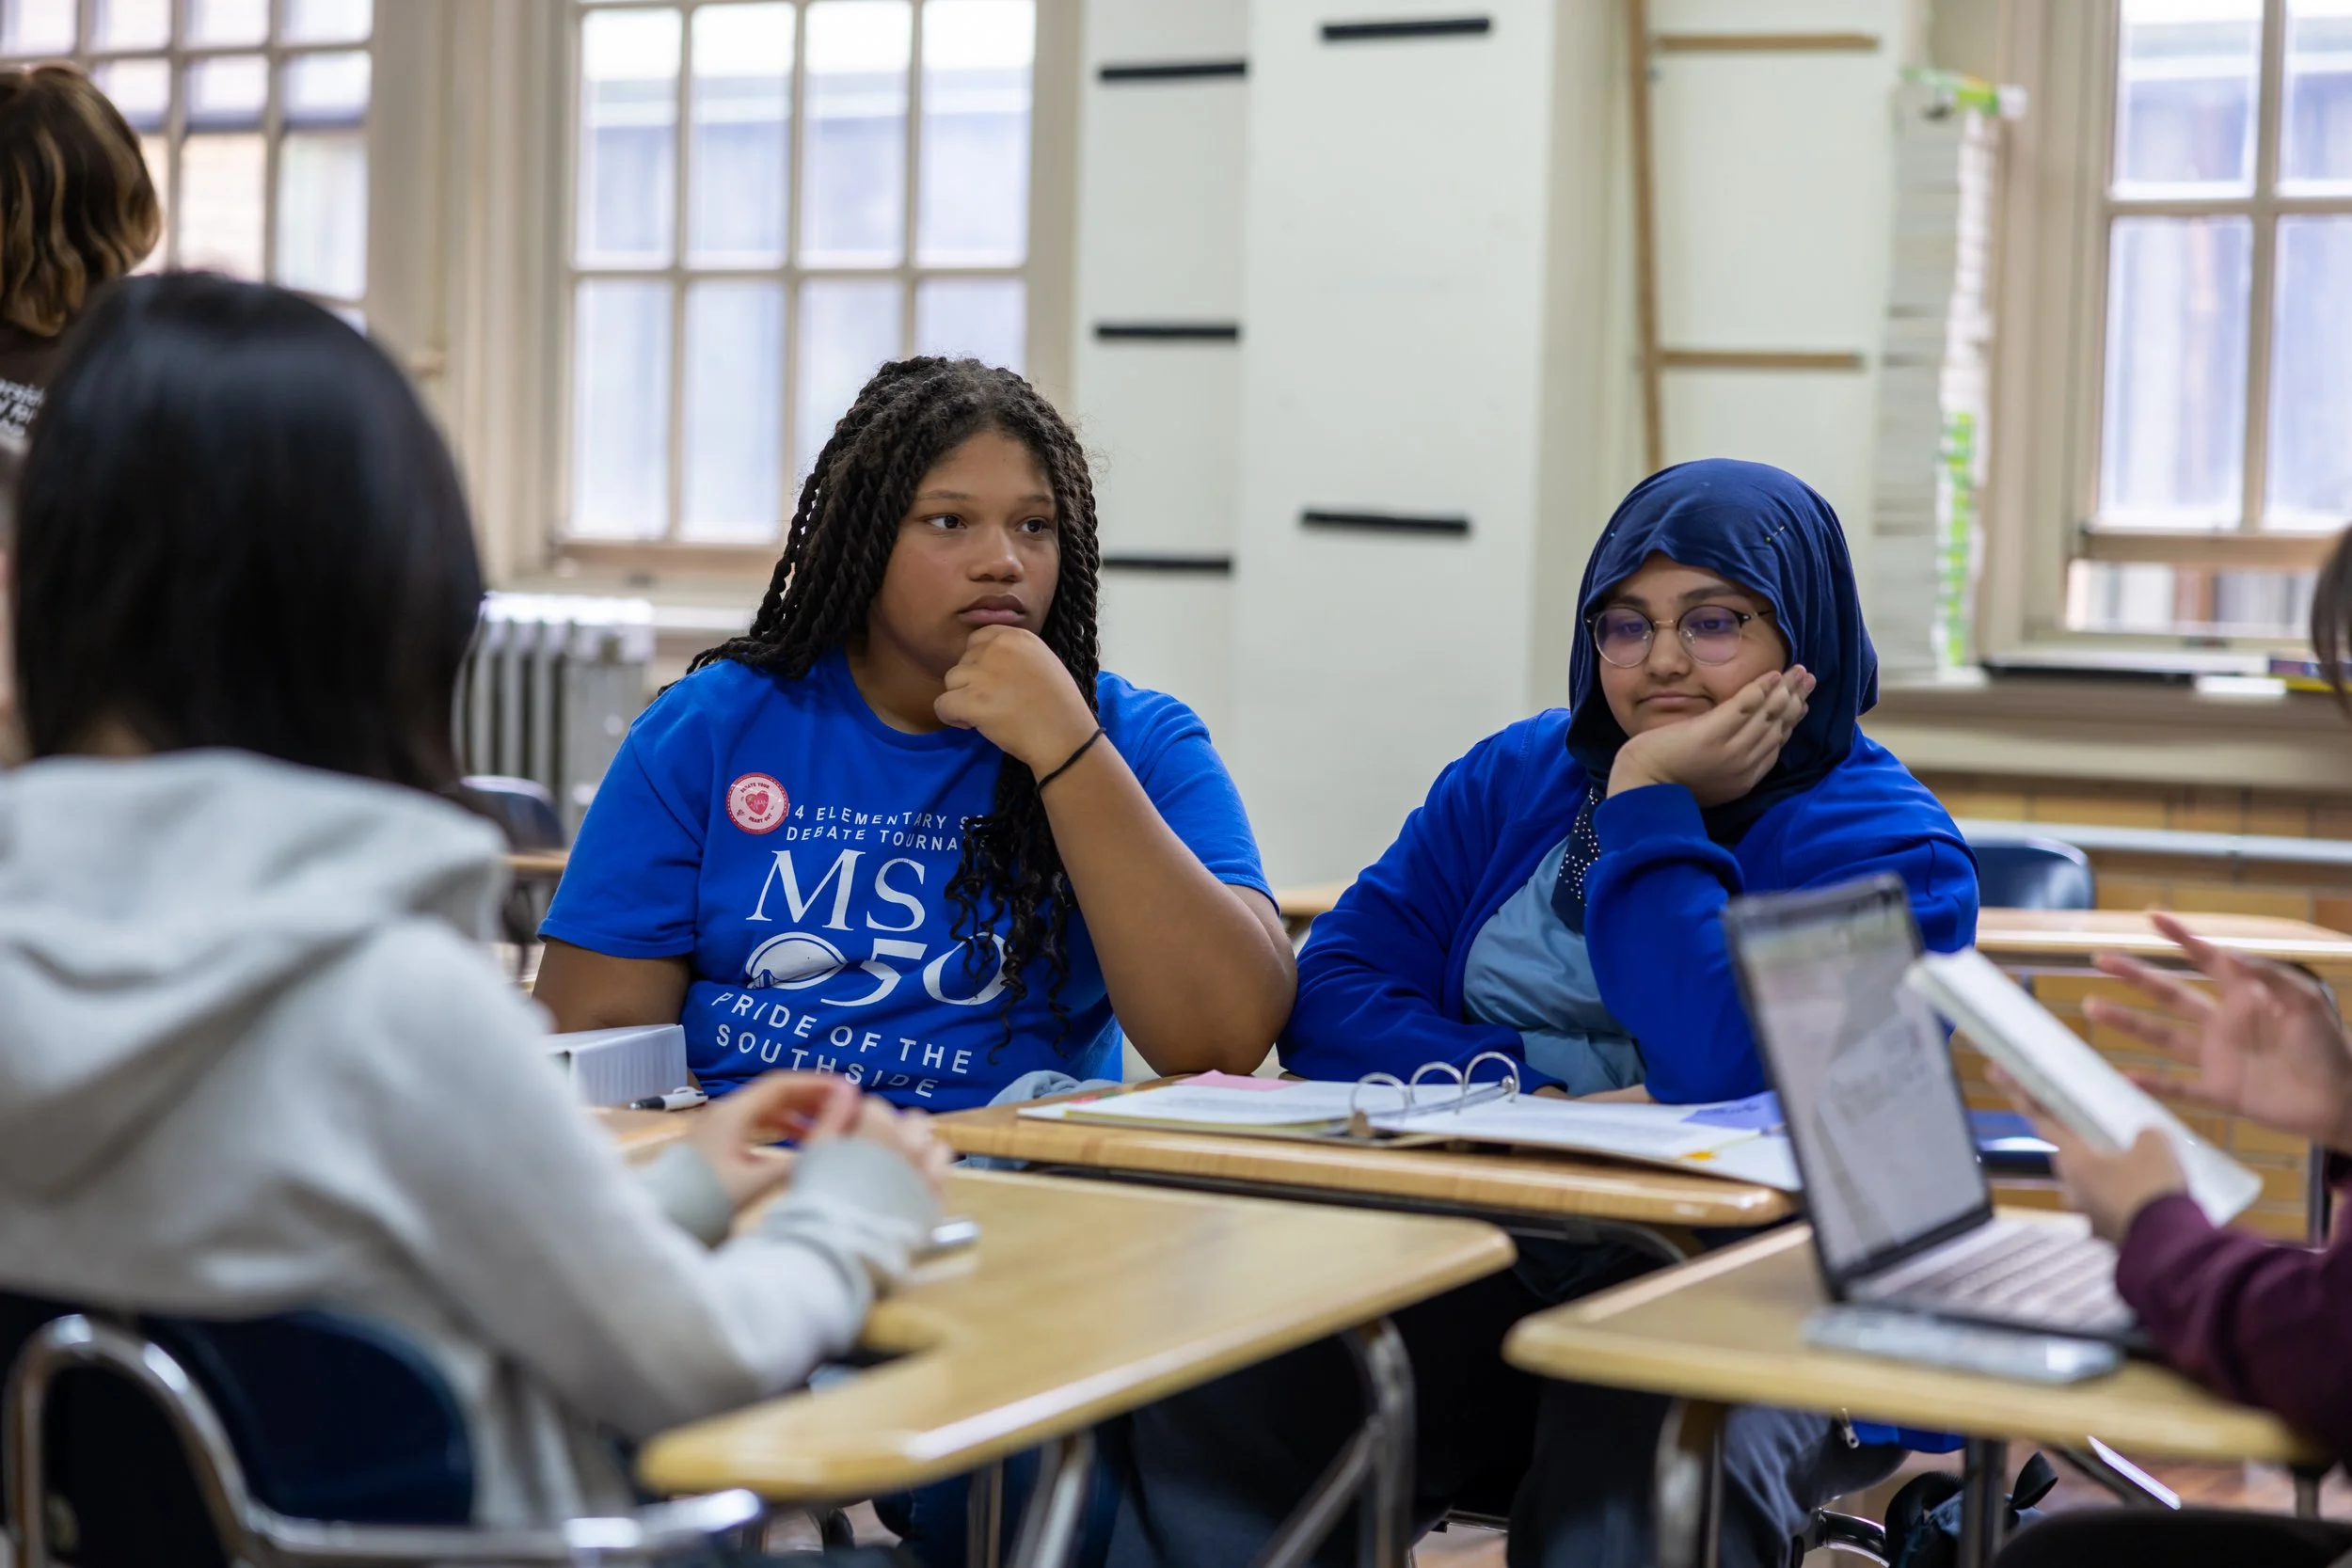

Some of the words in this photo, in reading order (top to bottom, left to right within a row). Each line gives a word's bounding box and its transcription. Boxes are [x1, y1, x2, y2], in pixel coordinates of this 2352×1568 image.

[786, 826, 866, 841] DEBATE
[880, 830, 966, 851] TOURNA
[816, 806, 947, 830] ELEMENTARY
[745, 848, 926, 932] MS
[711, 992, 818, 1038] PRIDE
[830, 1025, 882, 1053] OF
[899, 1037, 973, 1074] THE
[716, 1023, 939, 1099] SOUTHSIDE
